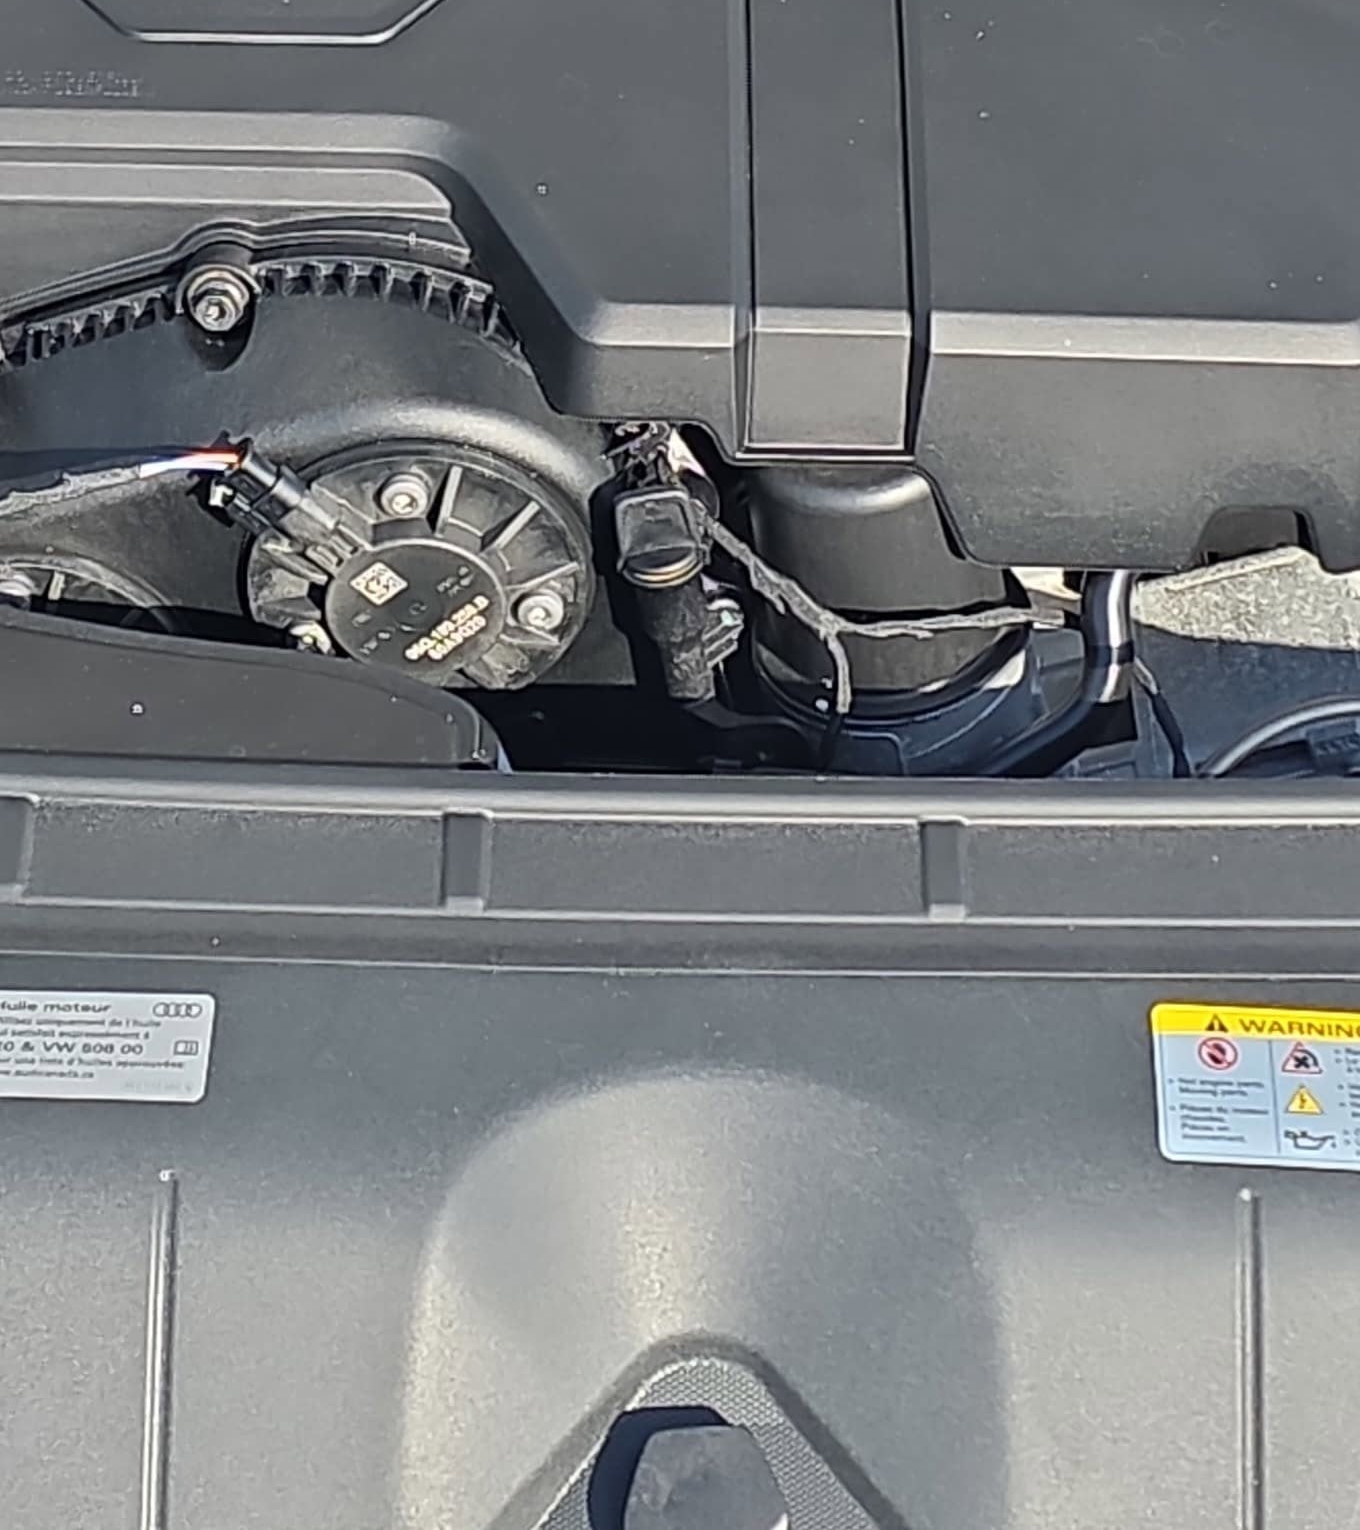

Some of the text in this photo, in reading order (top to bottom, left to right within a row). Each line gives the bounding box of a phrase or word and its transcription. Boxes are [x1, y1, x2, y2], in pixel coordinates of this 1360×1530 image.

[43, 1002, 112, 1013] moteur
[21, 1042, 36, 1053] &
[42, 1040, 77, 1054] VW
[119, 1043, 145, 1056] 00
